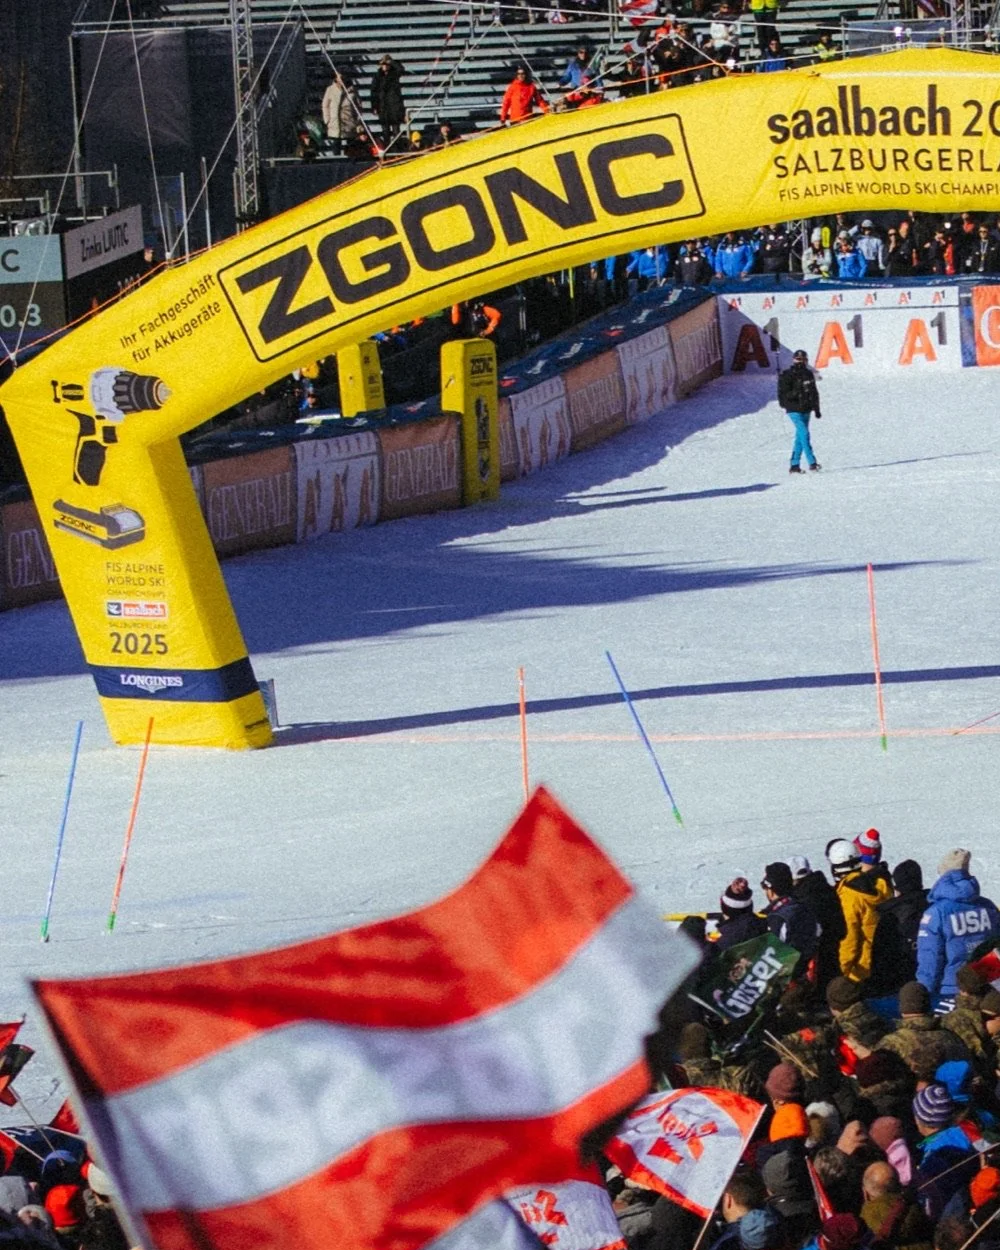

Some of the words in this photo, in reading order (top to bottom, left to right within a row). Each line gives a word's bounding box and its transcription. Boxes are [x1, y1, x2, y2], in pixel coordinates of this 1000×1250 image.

[767, 84, 950, 144] saalbach
[779, 189, 800, 201] FIS
[804, 182, 853, 198] ALPINE
[856, 182, 911, 195] WORLD
[915, 182, 937, 194] SKI
[235, 134, 685, 343] ZGONC
[120, 332, 137, 349] Ihr
[138, 273, 216, 333] Fachgeschäft
[132, 348, 150, 364] für
[154, 300, 222, 352] Akkugeräte
[814, 314, 863, 369] A1
[898, 311, 947, 366] A1
[106, 562, 121, 573] FIS
[125, 563, 164, 574] ALPINE
[106, 575, 145, 587] WORLD
[110, 632, 168, 655] 2025
[120, 674, 183, 687] LONGINES
[950, 908, 992, 936] USA
[713, 947, 783, 1018] Gösser
